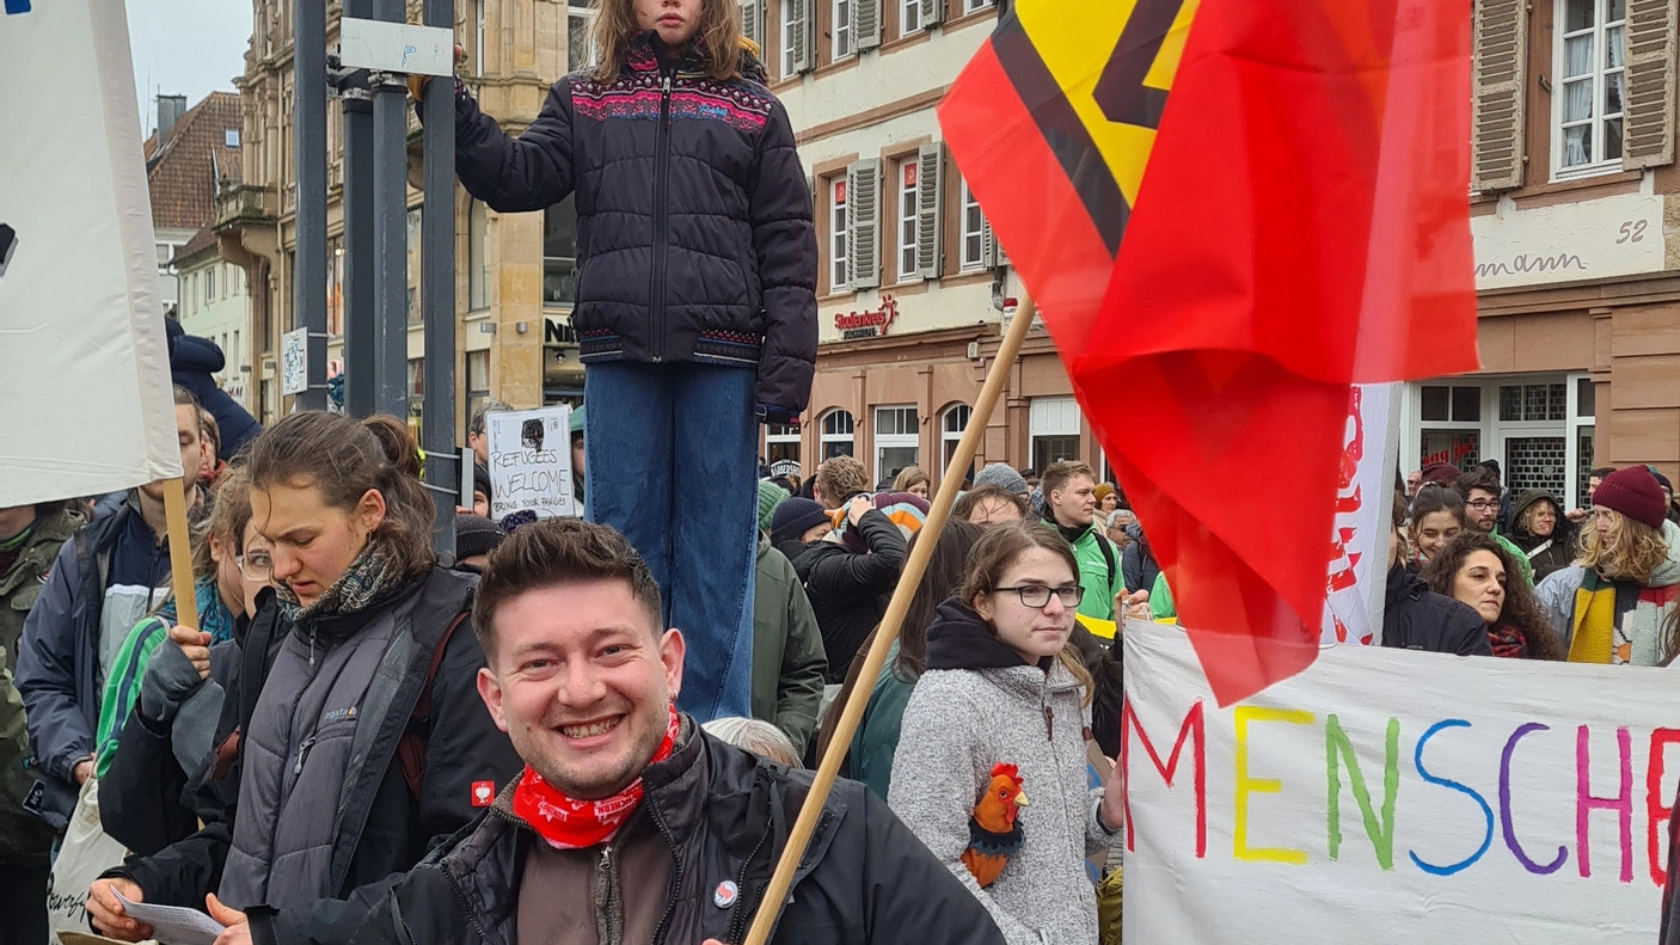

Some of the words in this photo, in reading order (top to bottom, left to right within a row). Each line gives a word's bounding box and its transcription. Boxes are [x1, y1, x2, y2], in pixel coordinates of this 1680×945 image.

[1615, 219, 1648, 245] 52
[490, 449, 558, 472] REFUGEES
[494, 469, 570, 499] WELCOME
